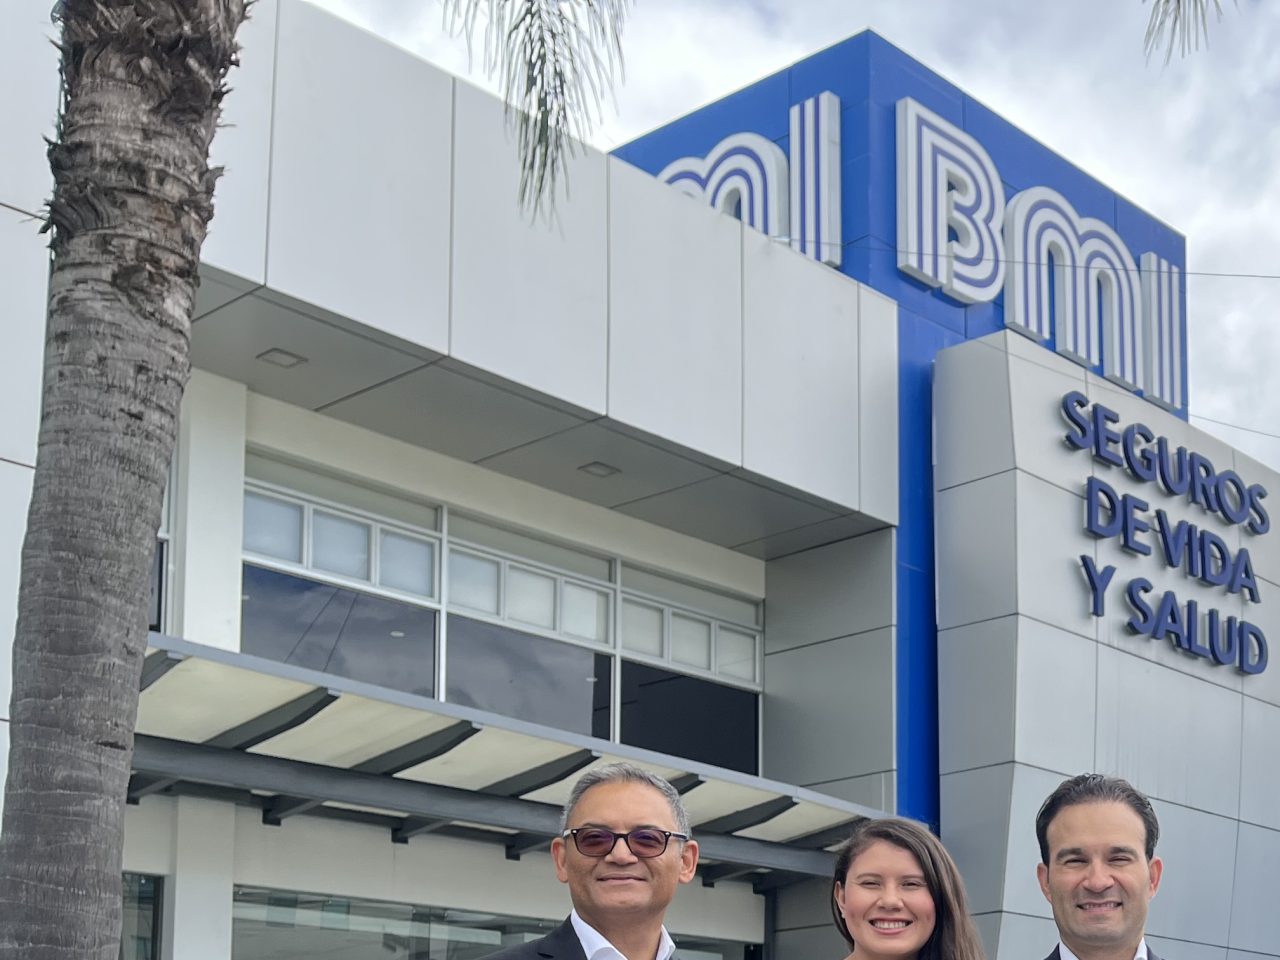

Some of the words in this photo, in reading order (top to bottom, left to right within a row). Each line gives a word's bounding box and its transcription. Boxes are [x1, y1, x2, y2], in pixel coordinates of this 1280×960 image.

[1062, 391, 1270, 535] SEGUROS
[1085, 476, 1151, 556] DE
[1155, 509, 1261, 604] VIDA
[1080, 555, 1116, 617] Y
[1127, 577, 1268, 675] SALUD
